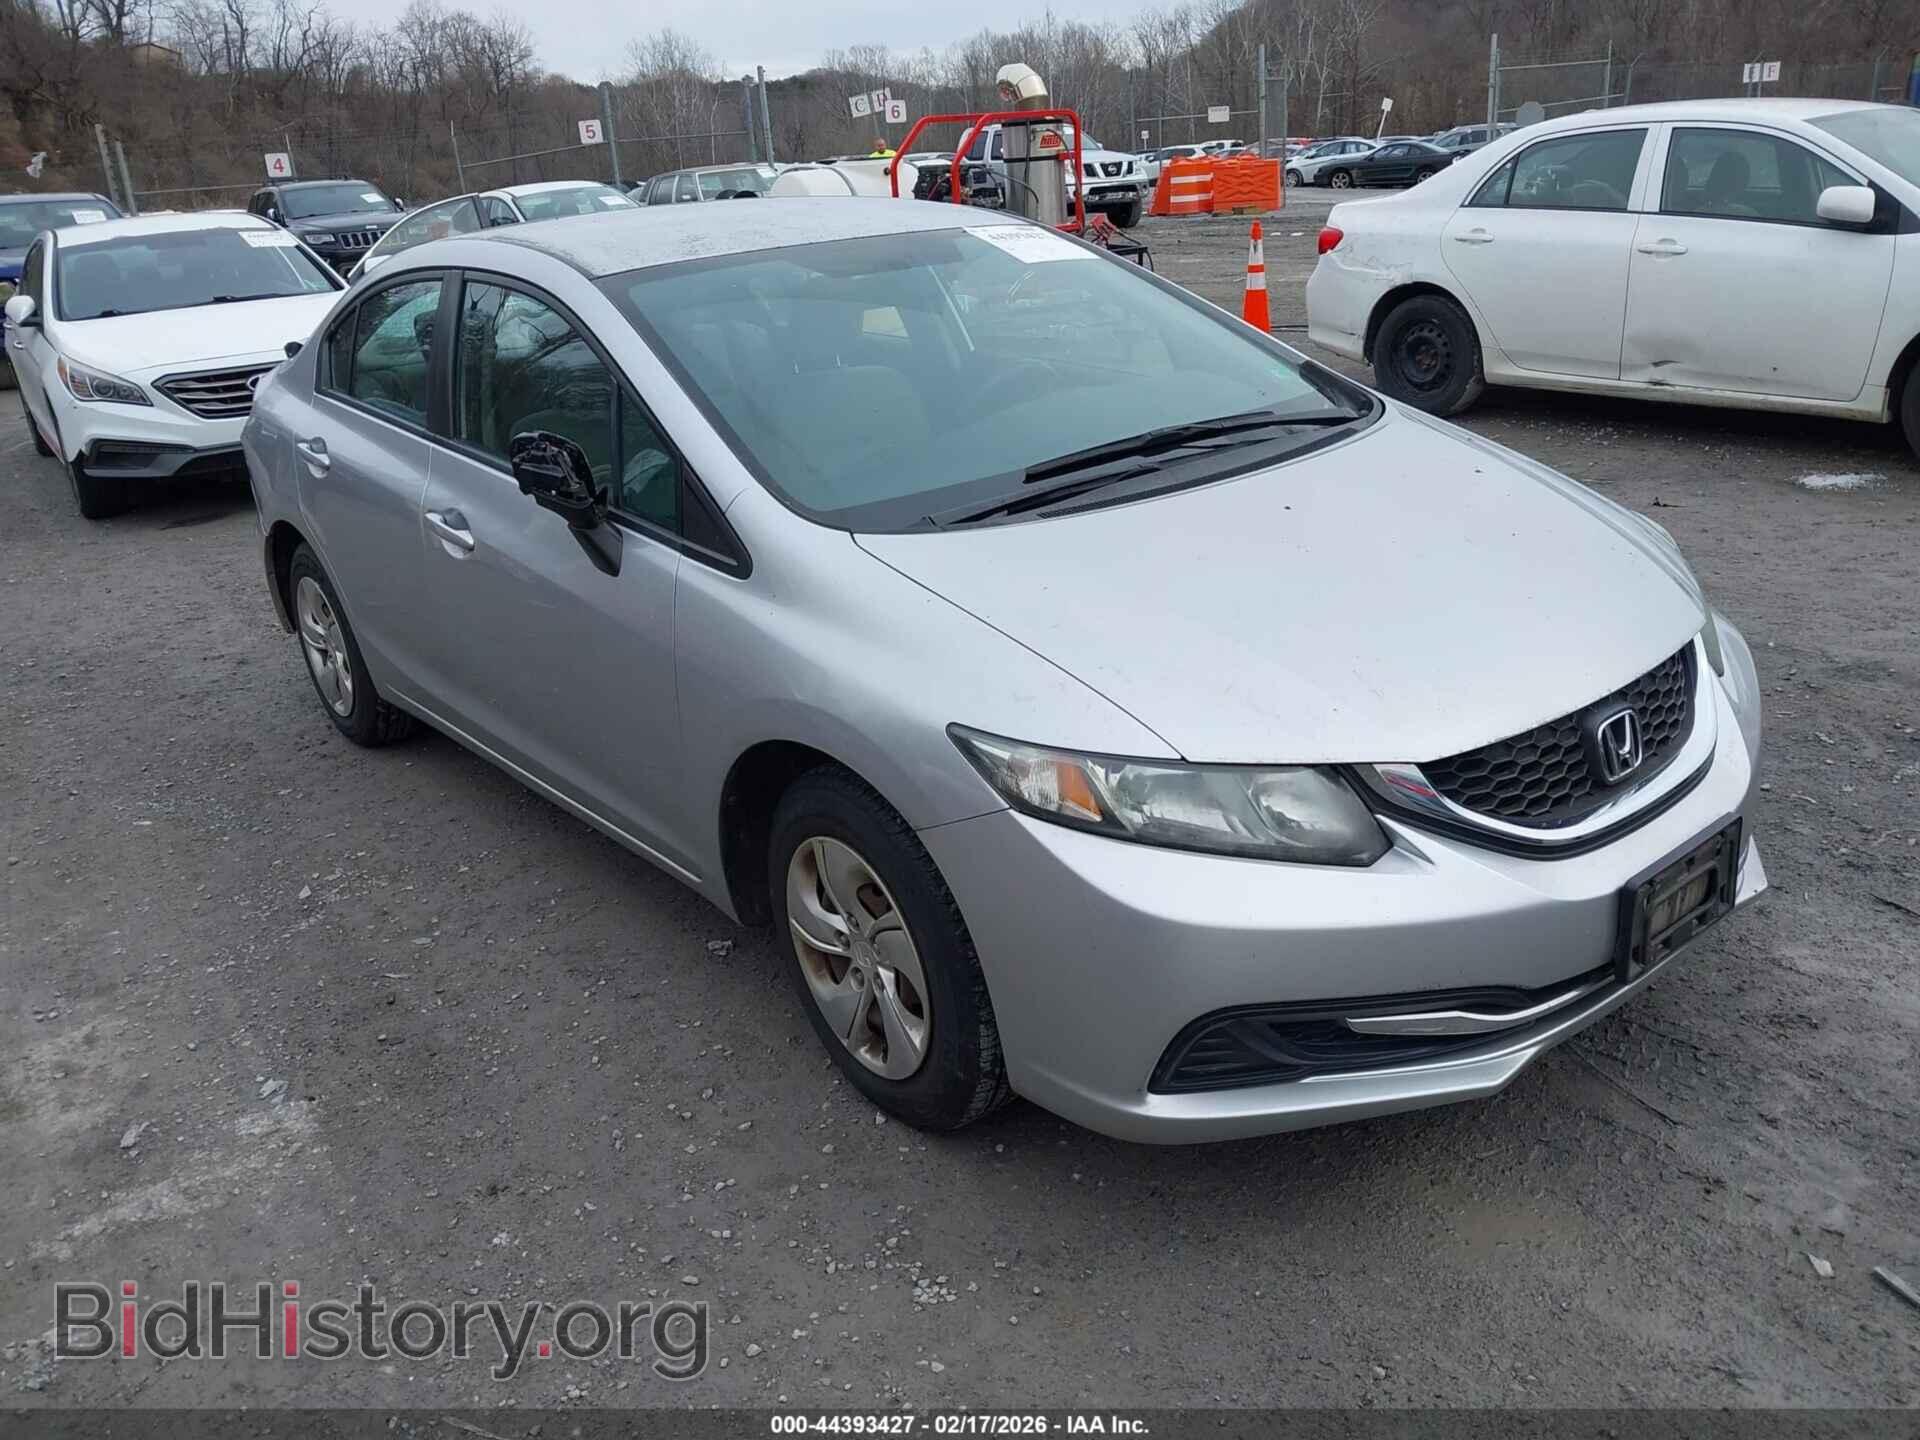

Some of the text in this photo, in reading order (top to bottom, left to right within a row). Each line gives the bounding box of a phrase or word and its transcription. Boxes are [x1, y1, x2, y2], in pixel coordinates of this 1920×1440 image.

[1767, 64, 1777, 78] F
[891, 104, 900, 119] 6
[585, 124, 596, 139] 5
[273, 158, 284, 172] 4
